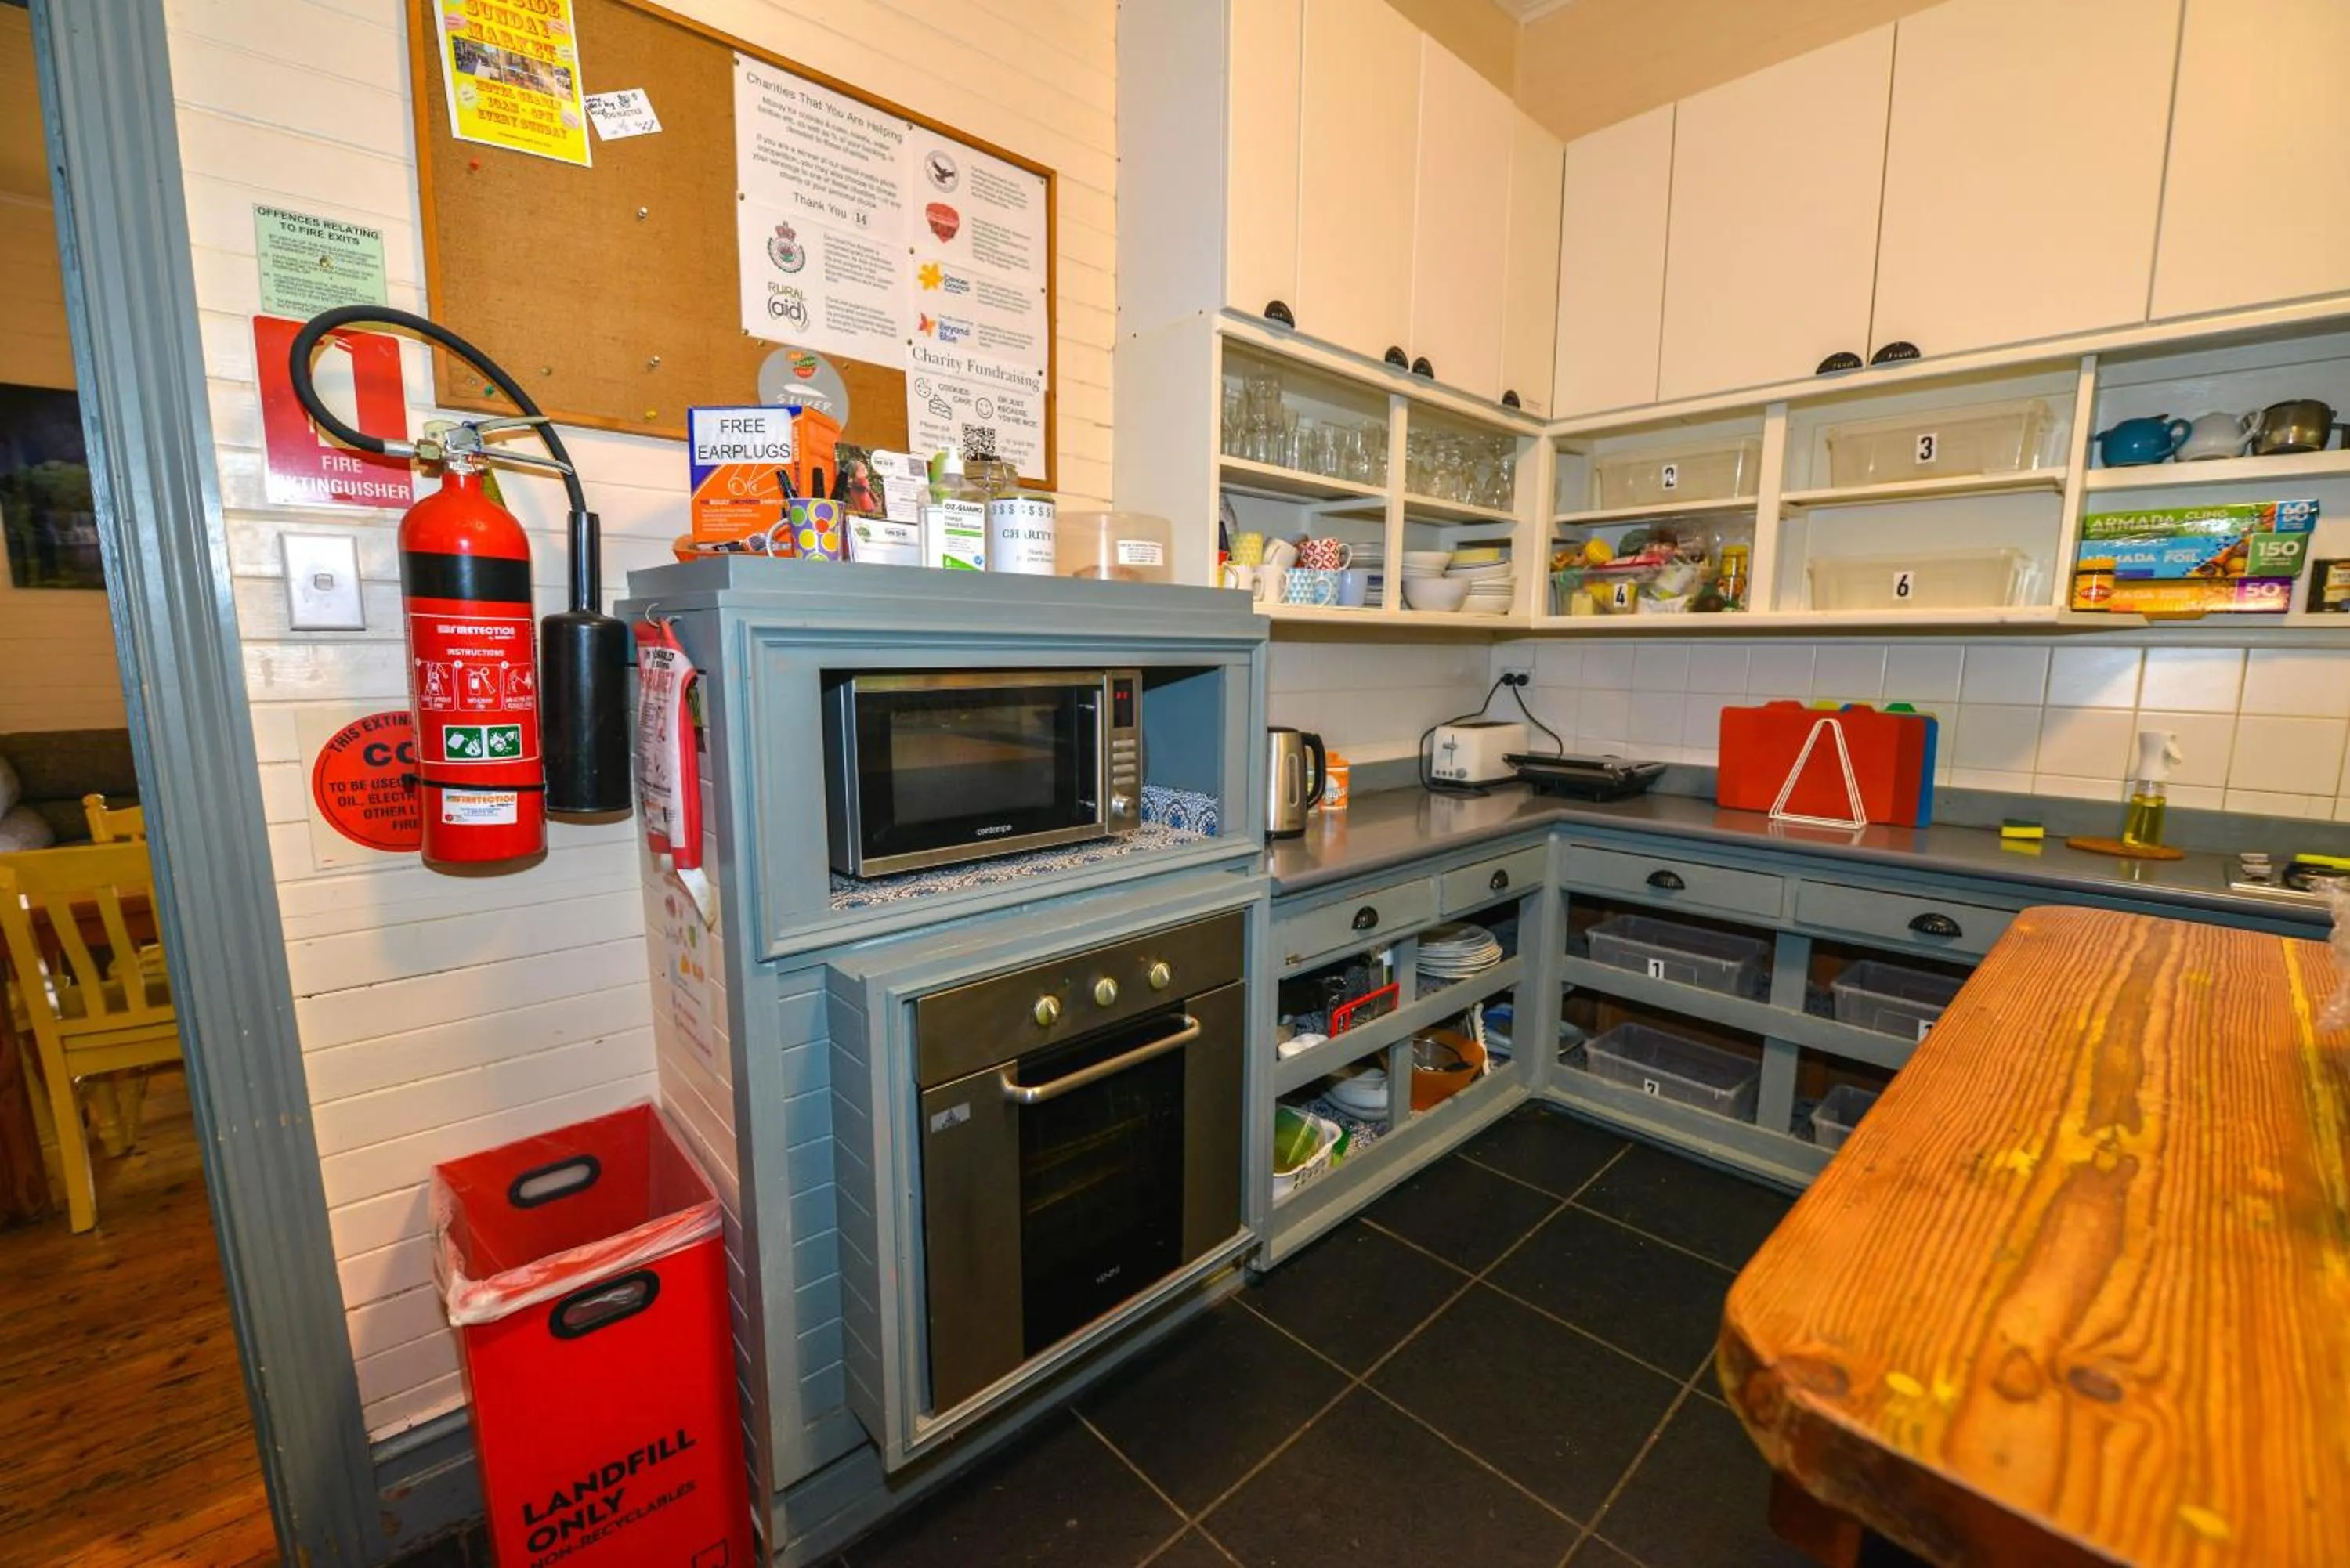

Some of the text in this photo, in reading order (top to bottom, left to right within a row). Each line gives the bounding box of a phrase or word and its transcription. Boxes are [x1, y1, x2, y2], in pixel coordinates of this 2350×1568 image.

[465, 0, 552, 39] SUNDAY
[468, 21, 557, 62] MARKET
[747, 72, 903, 145] Charities That You Are Helping
[794, 193, 847, 219] Thank You
[257, 206, 379, 240] OFFENCES RELATING
[279, 222, 360, 246] TO FIRE EXITS
[768, 281, 807, 301] RURAL
[772, 298, 801, 320] aid
[913, 346, 1040, 392] Charity Fundraising
[720, 418, 766, 433] FREE
[698, 443, 791, 461] EARPLUGS
[1920, 436, 1933, 460] 3
[321, 455, 363, 474] FIRE
[280, 475, 411, 500] TINGUISHER
[1665, 468, 1674, 487] 2
[2164, 550, 2200, 564] FOIL
[2257, 540, 2300, 557] 150
[1615, 585, 1625, 605] 4
[1896, 574, 1909, 597] 6
[2246, 582, 2281, 598] 50
[329, 714, 412, 753] THIS EXTIN
[329, 782, 346, 793] TO
[350, 779, 366, 791] BE
[368, 792, 416, 804] ELECTR
[363, 806, 406, 820] OTHER
[1652, 963, 1660, 977] 1
[523, 1429, 698, 1526] LANDFILL
[526, 1488, 625, 1554] ONLY
[529, 1480, 697, 1568] NON-RECYCLABLES
